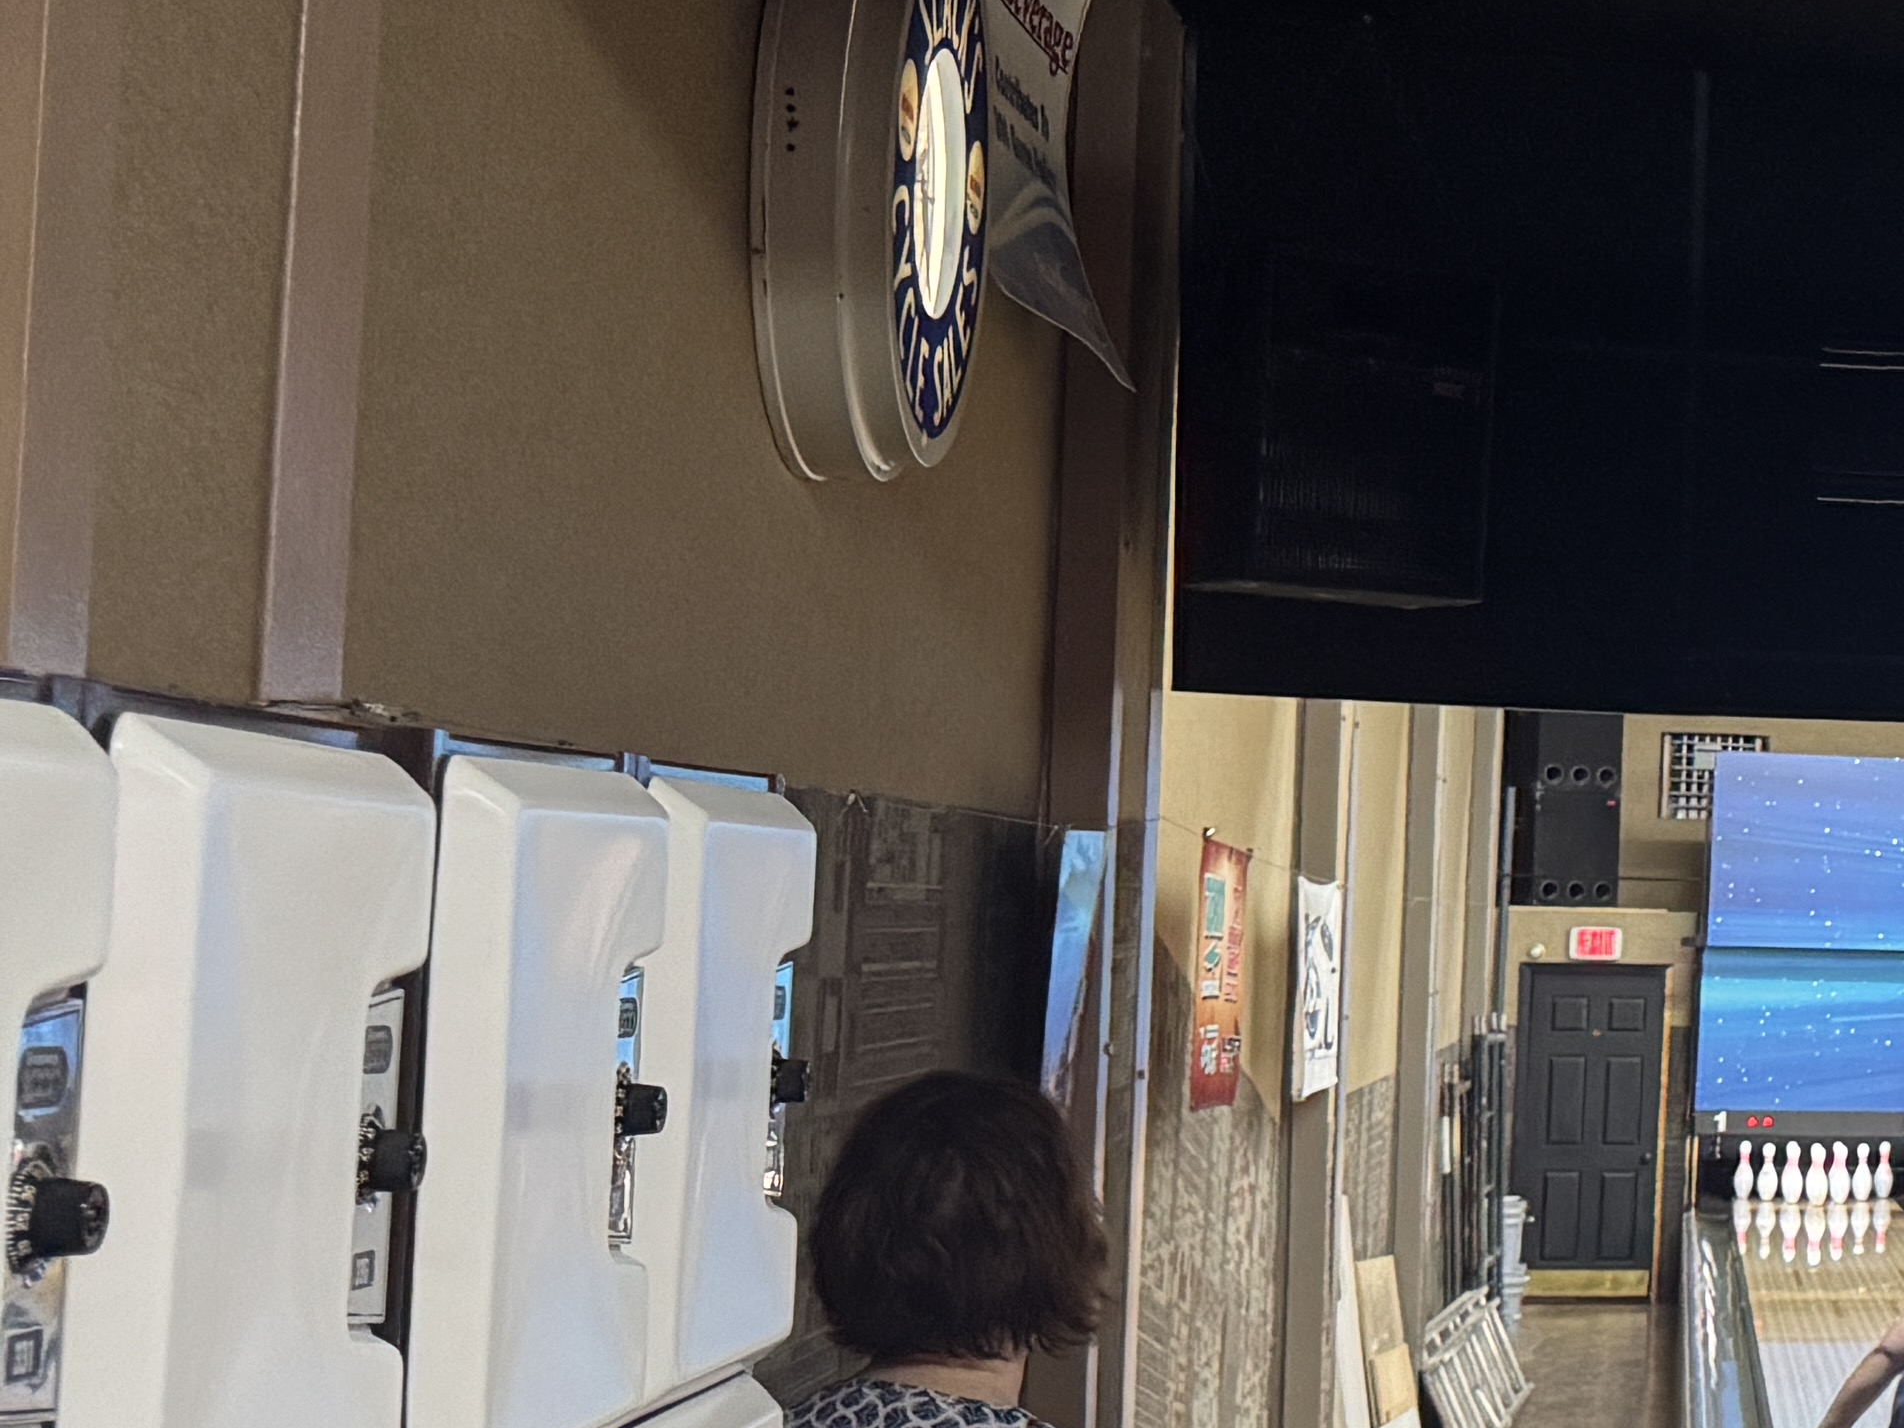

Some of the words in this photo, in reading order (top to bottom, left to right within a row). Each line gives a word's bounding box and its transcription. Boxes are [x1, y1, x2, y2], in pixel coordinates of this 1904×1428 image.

[893, 184, 929, 446] CYCLE
[933, 245, 978, 427] SALES
[1576, 928, 1616, 955] EXIT
[1713, 1110, 1728, 1133] 1
